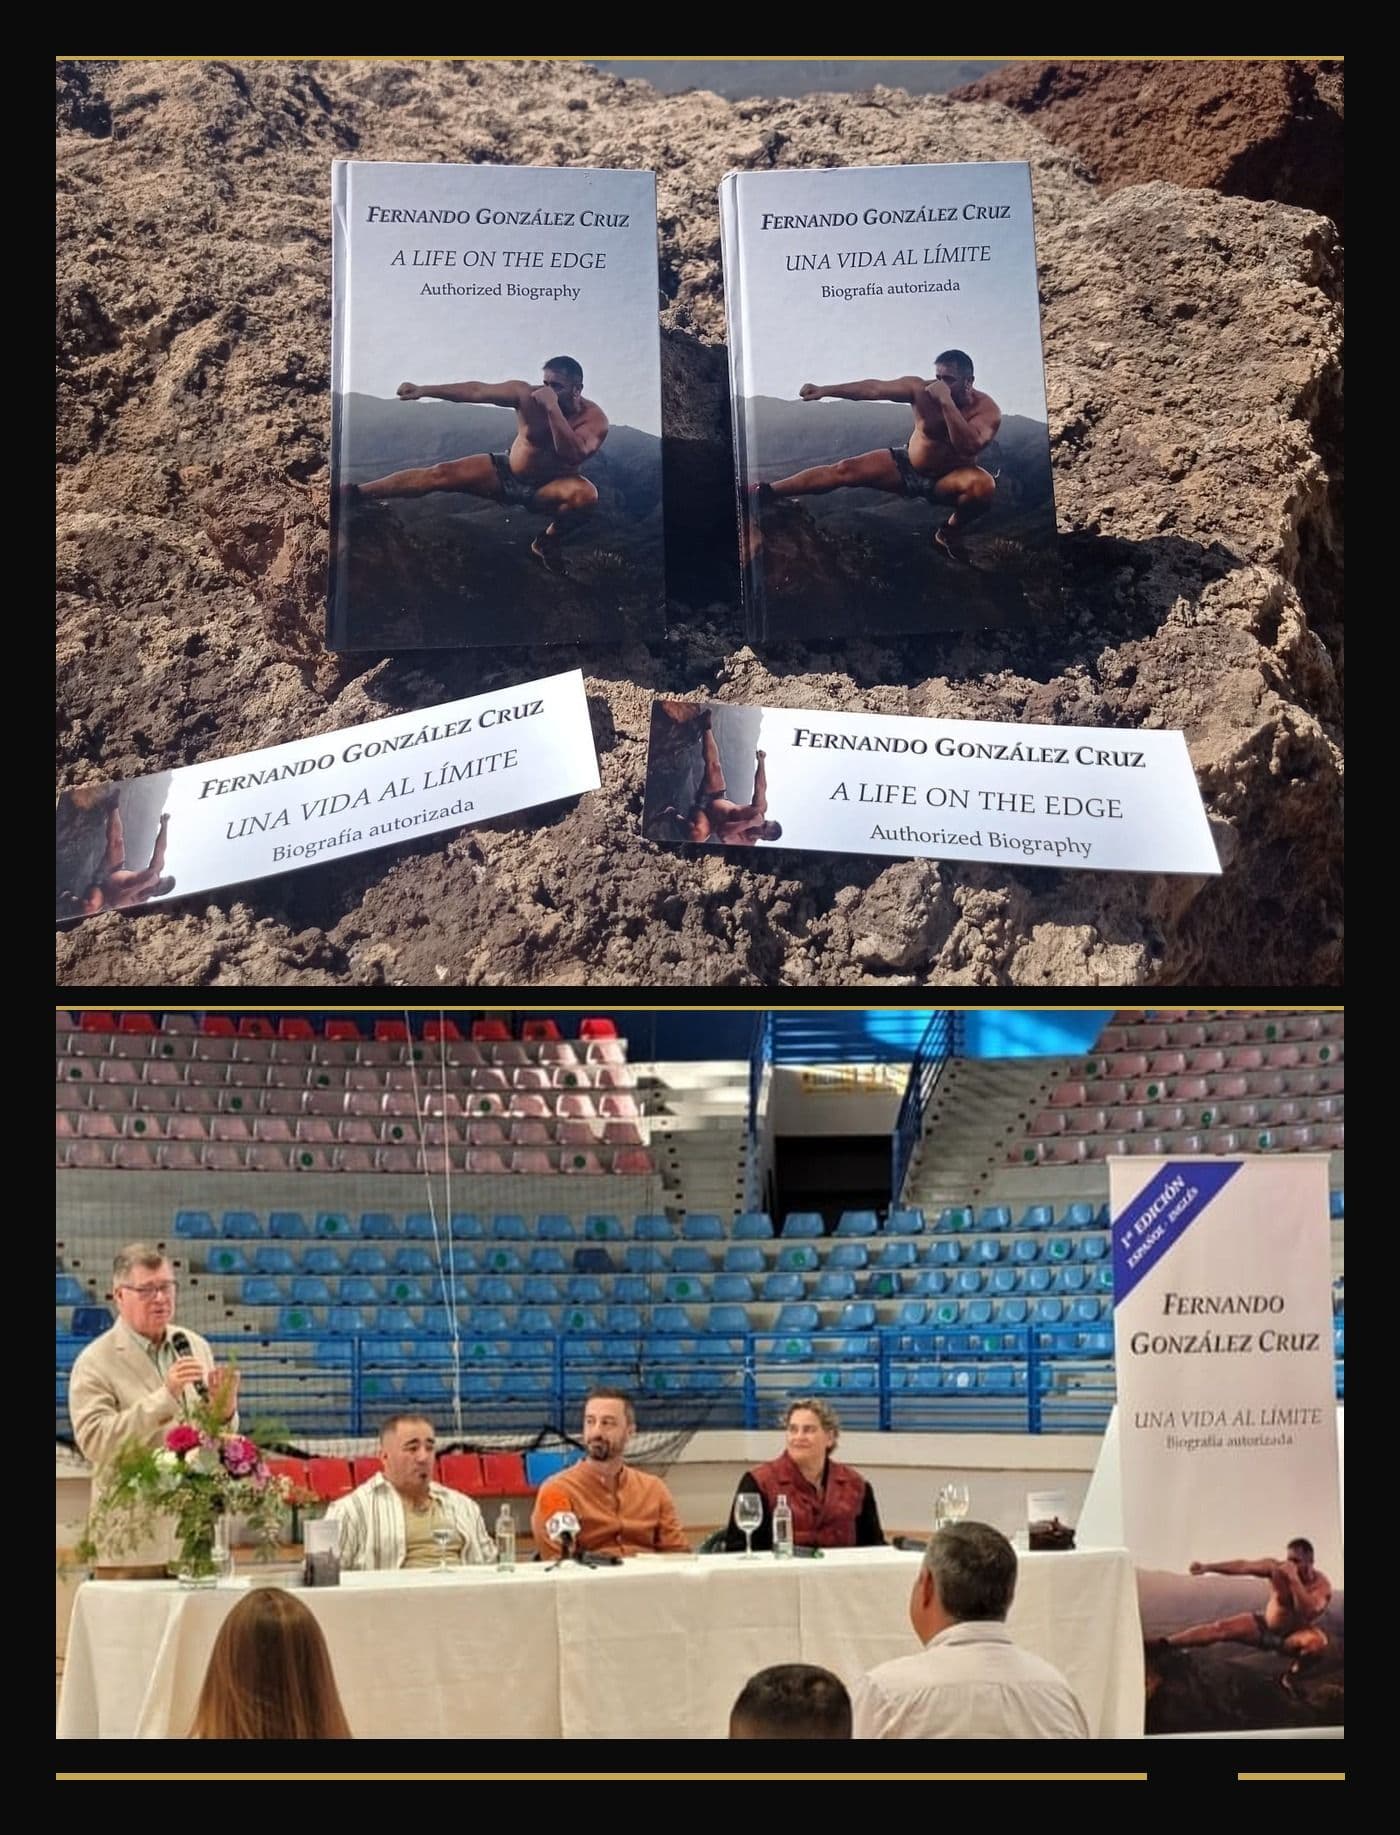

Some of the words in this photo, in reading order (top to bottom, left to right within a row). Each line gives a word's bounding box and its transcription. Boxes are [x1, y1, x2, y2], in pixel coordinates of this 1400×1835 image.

[366, 205, 471, 225] FERNANDO
[475, 207, 576, 228] GONZÁLEZ
[579, 210, 631, 229] CRUZ
[760, 212, 859, 231] FERNANDO
[863, 205, 959, 226] GONZÁLEZ
[962, 203, 1012, 221] CRUZ
[389, 249, 407, 267] A
[412, 249, 457, 267] LIFE
[463, 250, 497, 268] ON
[502, 251, 545, 268] THE
[549, 252, 607, 270] EDGE
[785, 253, 833, 272] UNA
[837, 250, 888, 269] VIDA
[892, 248, 919, 267] AL
[923, 243, 992, 265] LÍMITE
[419, 282, 502, 298] Authorized
[506, 283, 581, 302] Biography
[820, 281, 884, 302] Biografía
[887, 278, 961, 296] autorizada
[198, 753, 335, 801] FERNANDO
[342, 718, 472, 765] GONZÁLEZ
[478, 699, 544, 730] CRUZ
[791, 727, 929, 755] FERNANDO
[934, 736, 1071, 765] GONZÁLEZ
[1075, 745, 1147, 768] CRUZ
[225, 809, 291, 841] UNA
[301, 791, 372, 822] VIDA
[377, 776, 415, 800] AL
[423, 749, 520, 792] LÍMITE
[829, 780, 850, 802] A
[858, 781, 918, 807] LIFE
[925, 786, 971, 810] ON
[977, 789, 1037, 814] THE
[1045, 795, 1124, 820] EDGE
[272, 827, 363, 863] Biografía
[368, 800, 475, 838] autorizada
[869, 823, 983, 848] Authorized
[987, 830, 1093, 859] Biography
[1134, 1175, 1185, 1235] EDICIÓN
[1161, 1292, 1285, 1317] FERNANDO
[1130, 1329, 1253, 1356] GONZÁLEZ
[1258, 1329, 1321, 1353] CRUZ
[1134, 1410, 1177, 1430] UNA
[1181, 1410, 1229, 1429] VIDA
[1233, 1408, 1257, 1427] AL
[1260, 1404, 1323, 1427] LÍMITE
[1166, 1434, 1224, 1452] Biografía
[1227, 1432, 1294, 1449] autorizada
